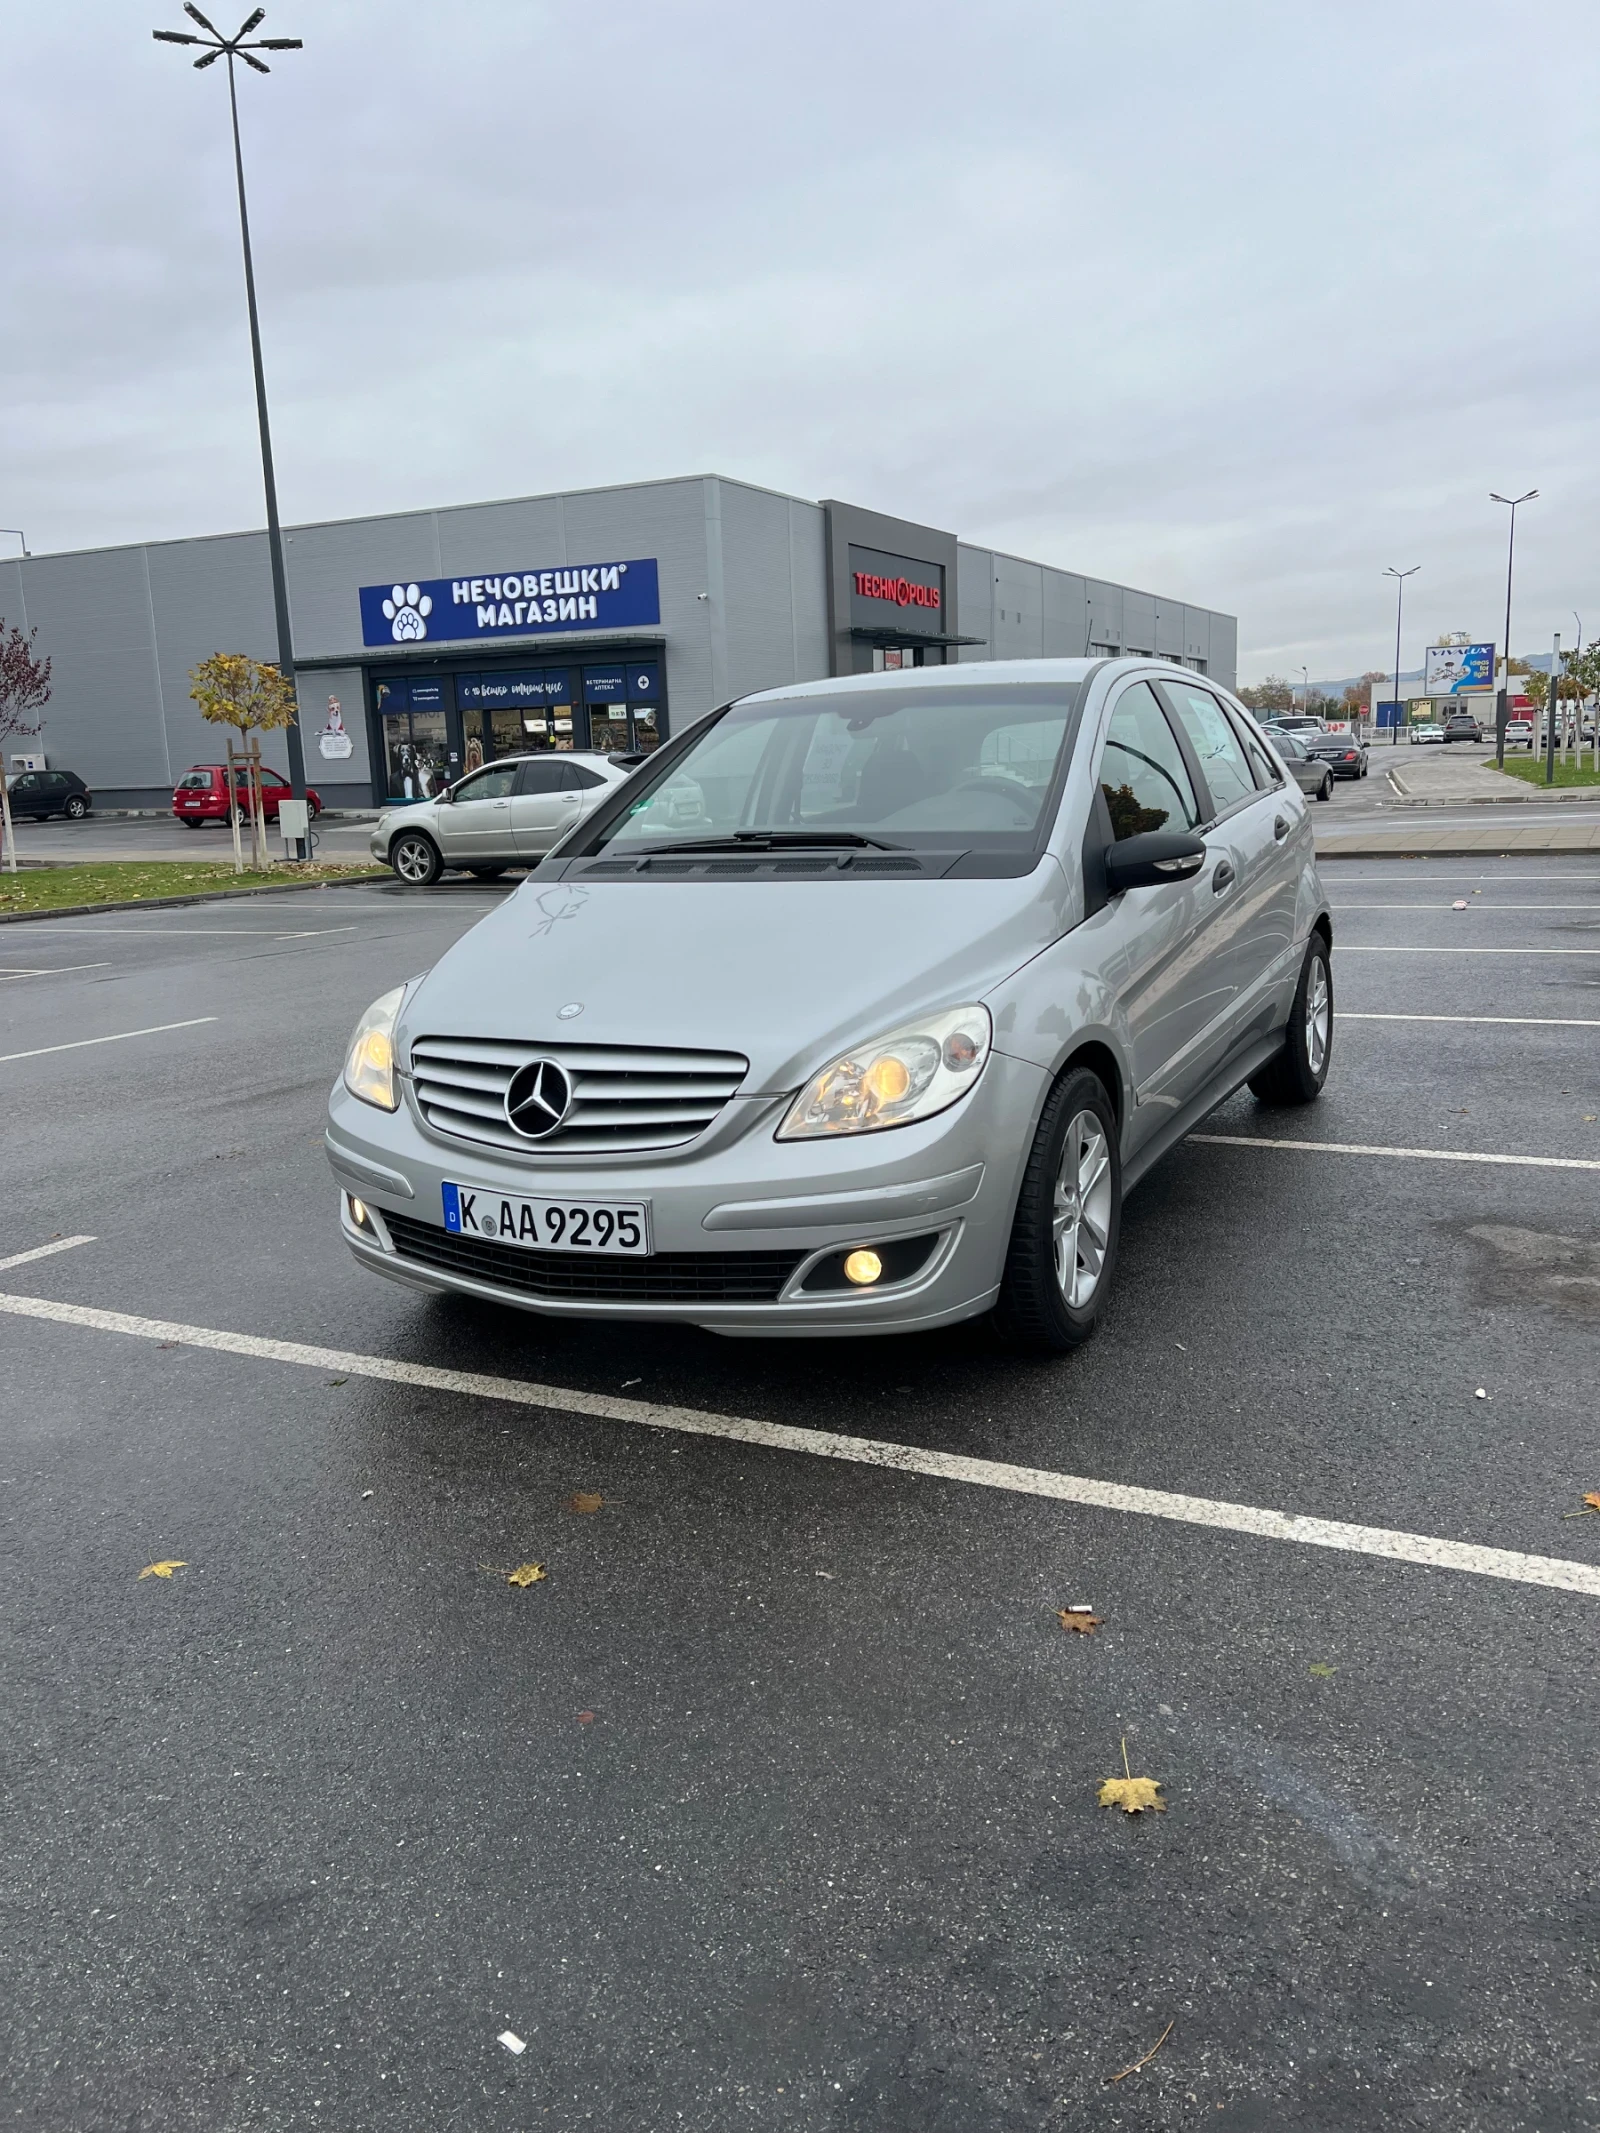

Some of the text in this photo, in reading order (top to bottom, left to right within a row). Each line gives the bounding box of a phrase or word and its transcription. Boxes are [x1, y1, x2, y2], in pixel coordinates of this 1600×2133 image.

[853, 572, 940, 607] TECHNOPOLIS
[476, 595, 598, 628] МАГАЗИН
[1431, 647, 1491, 656] VIVALUX
[449, 1212, 456, 1222] D
[460, 1192, 641, 1248] K AA 9295
